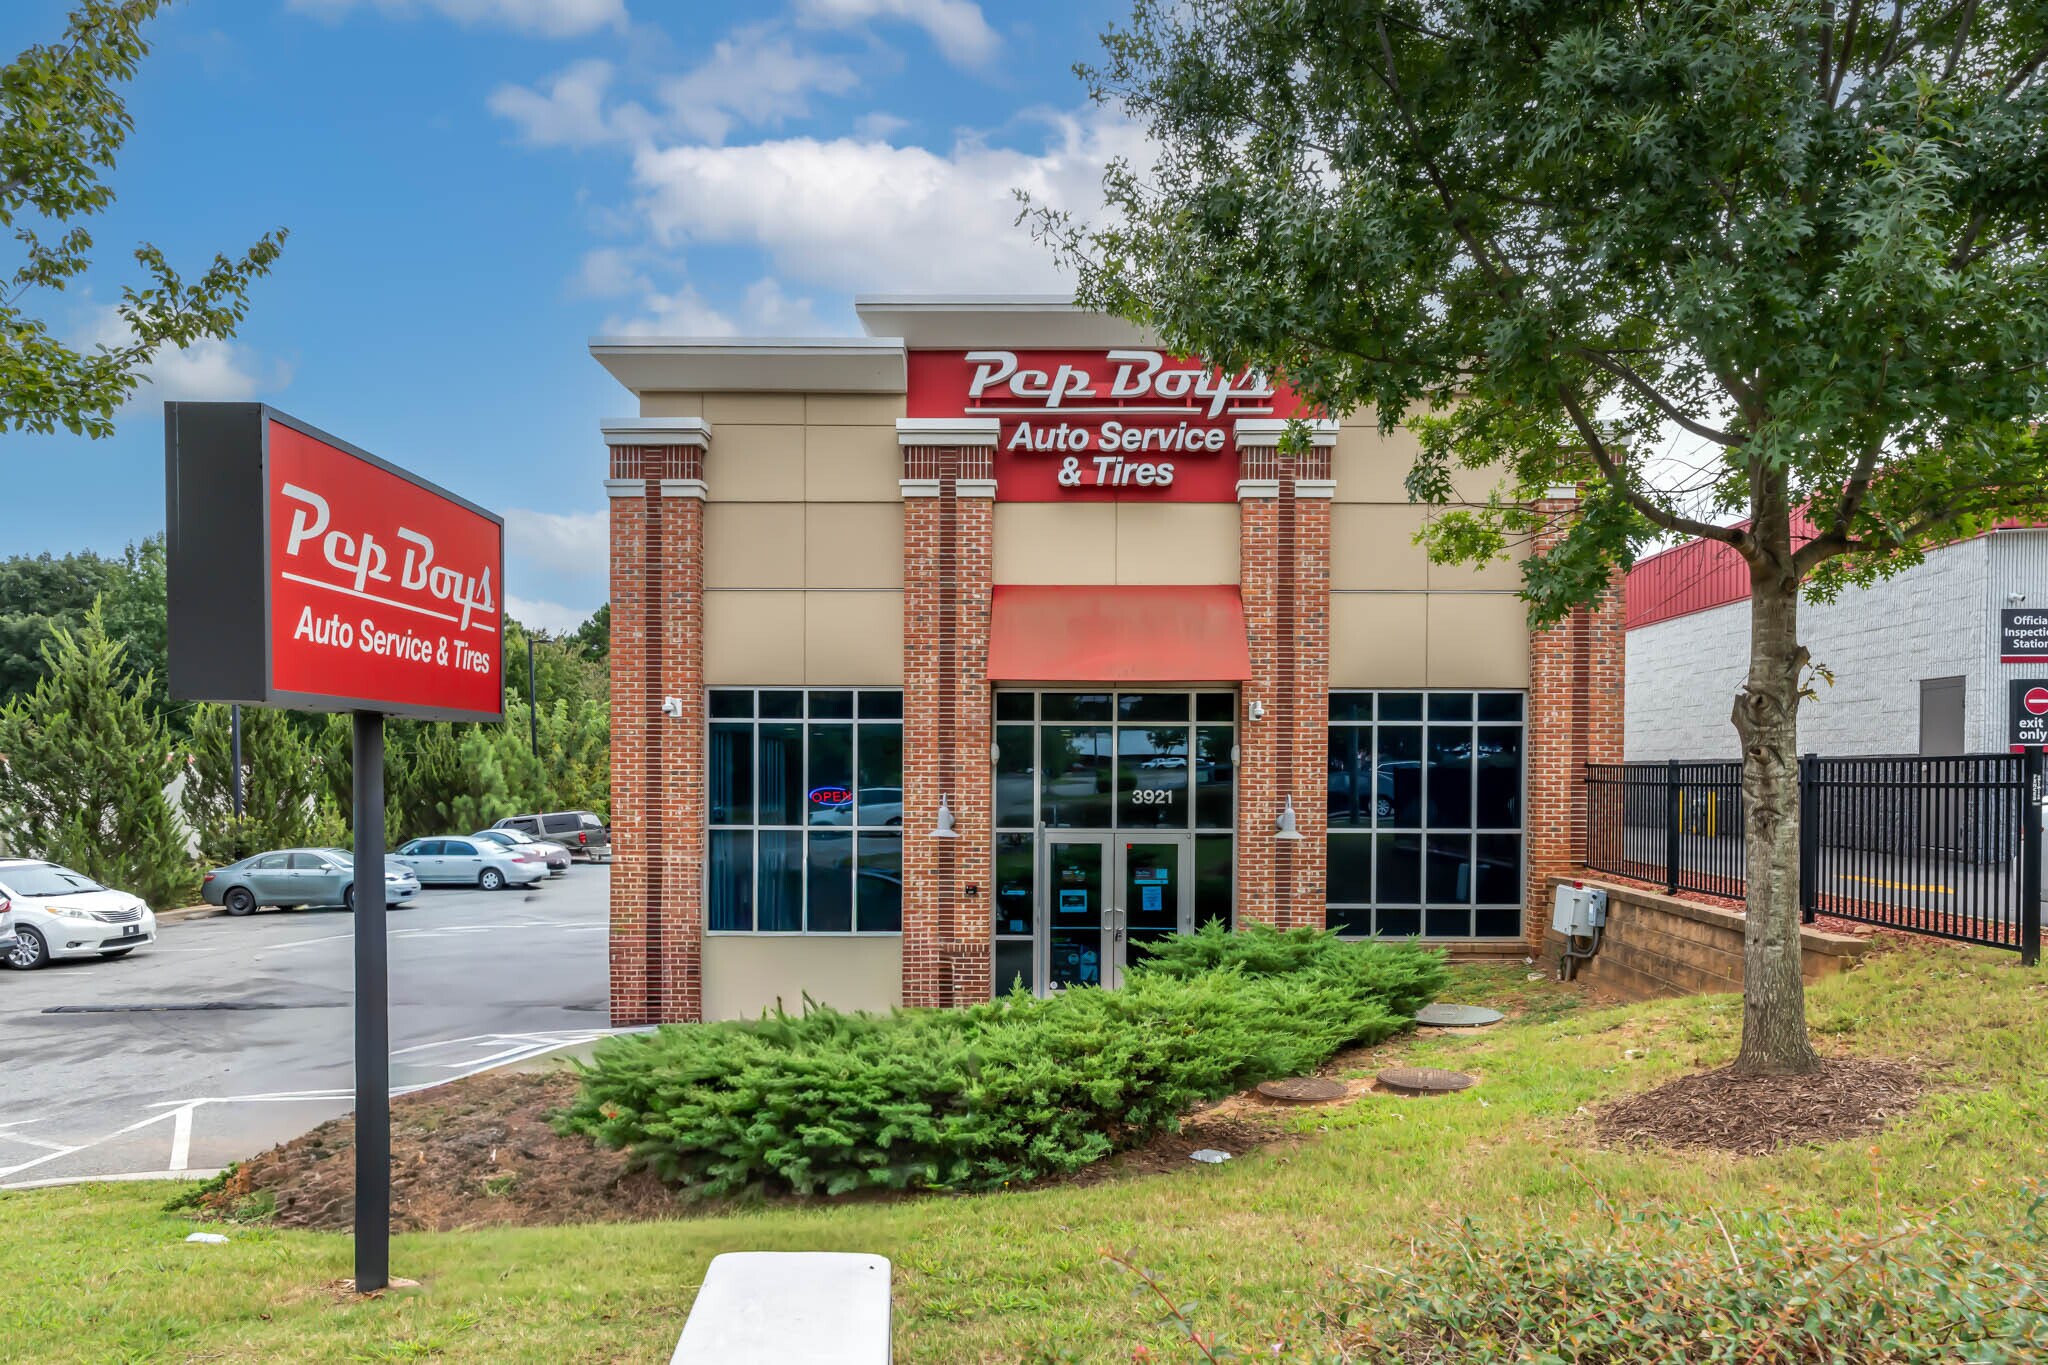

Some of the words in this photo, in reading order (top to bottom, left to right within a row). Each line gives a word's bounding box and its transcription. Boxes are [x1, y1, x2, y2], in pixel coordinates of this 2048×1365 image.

[964, 351, 1096, 408] Pep
[1106, 350, 1275, 419] Boys
[1007, 421, 1090, 452] Auto
[1098, 421, 1226, 452] Service
[1057, 456, 1083, 487] &
[1093, 456, 1174, 487] Tires
[281, 482, 391, 592] Pep
[397, 526, 495, 631] Boys
[293, 605, 354, 649] Auto
[358, 618, 433, 663] Service
[436, 636, 449, 667] &
[453, 639, 490, 674] Tires
[2019, 717, 2044, 728] exit
[2019, 729, 2048, 742] only
[811, 791, 852, 803] OPEN
[1132, 789, 1173, 804] 3921
